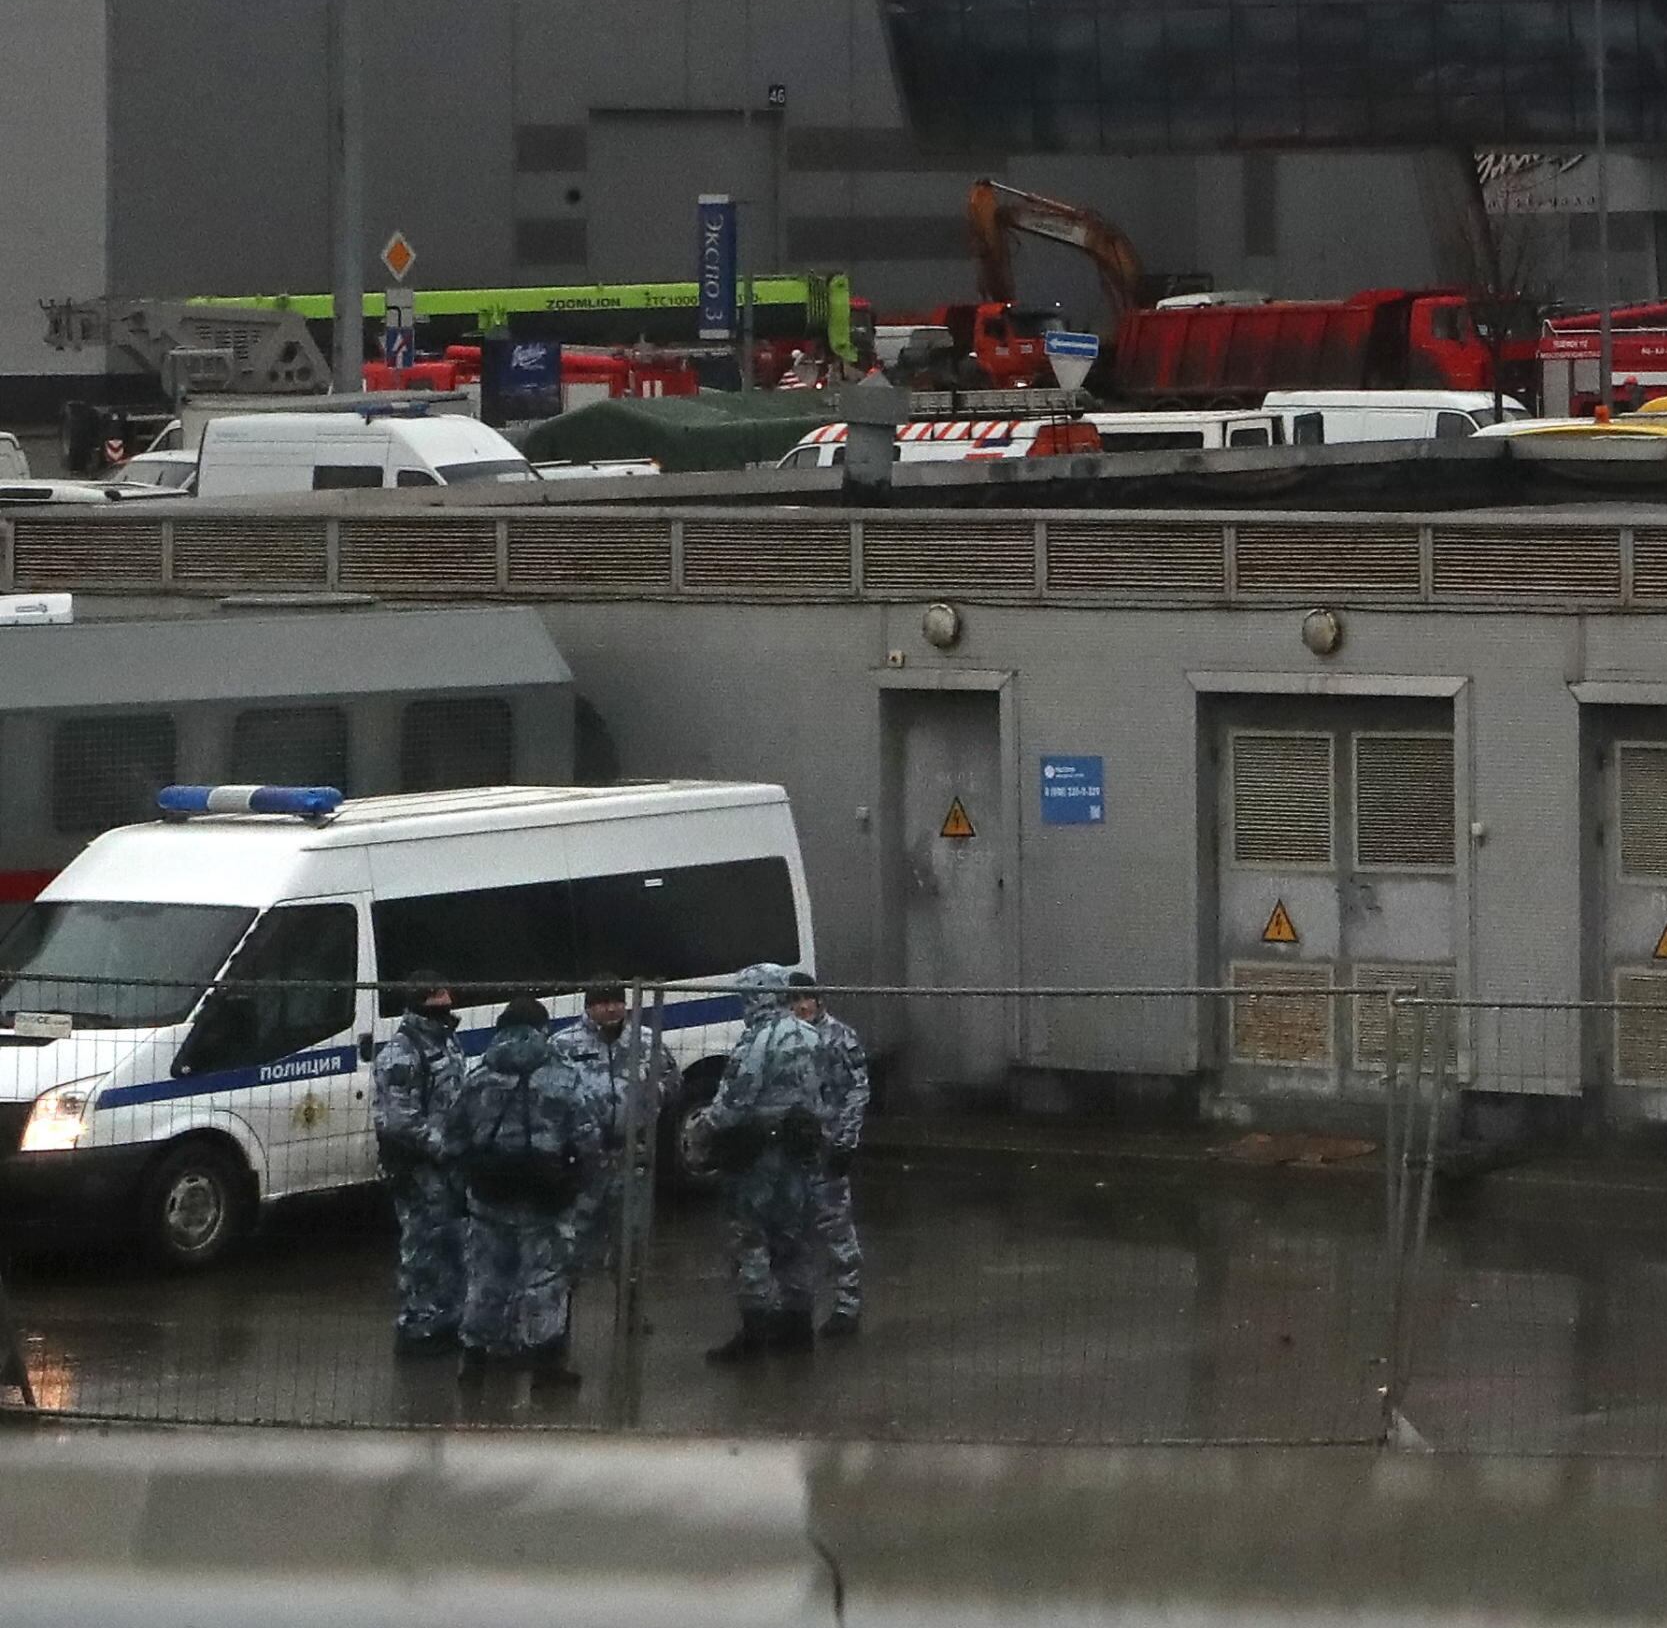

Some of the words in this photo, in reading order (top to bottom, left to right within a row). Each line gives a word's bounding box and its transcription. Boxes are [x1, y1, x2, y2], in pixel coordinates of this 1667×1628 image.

[704, 213, 724, 298] ЭКСПО
[546, 297, 621, 310] ZOOMLION
[705, 307, 723, 321] 3
[260, 1056, 341, 1081] ПОЛИЦИЯ
